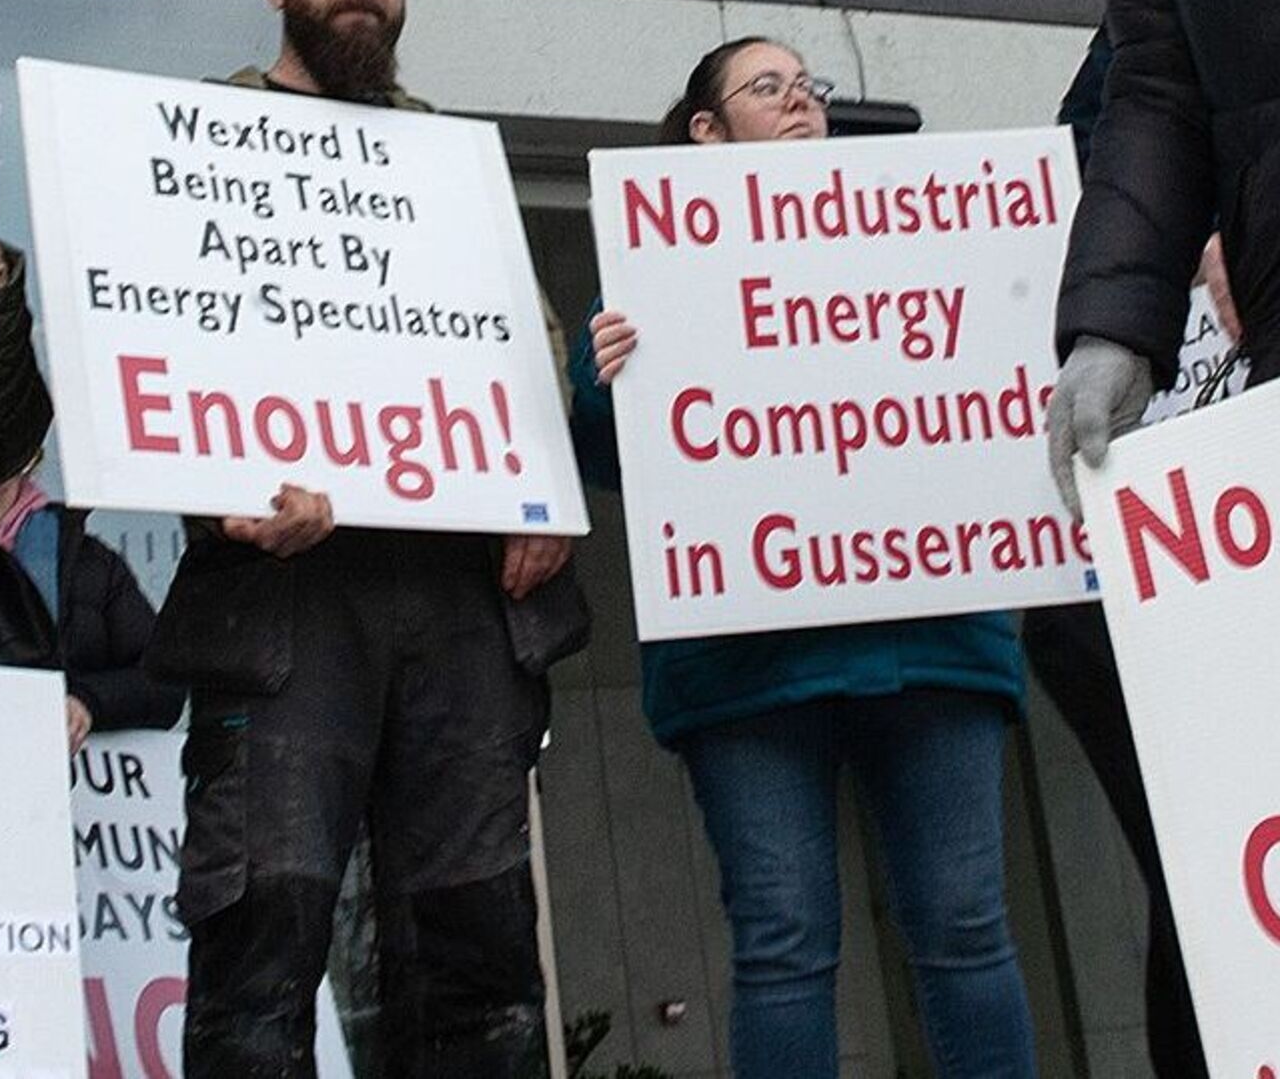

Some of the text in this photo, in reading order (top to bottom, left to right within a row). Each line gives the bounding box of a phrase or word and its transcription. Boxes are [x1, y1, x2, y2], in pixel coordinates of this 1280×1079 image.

[157, 101, 389, 165] Wexford Is
[151, 158, 414, 222] Being Taken
[624, 157, 1057, 249] No Industrial
[200, 220, 390, 286] Apart By
[87, 268, 510, 342] Energy Speculators
[740, 277, 964, 360] Energy
[116, 354, 522, 501] Enough!
[664, 523, 724, 598] in
[1116, 468, 1272, 602] No
[70, 747, 150, 799] UR
[80, 891, 194, 943] AYS
